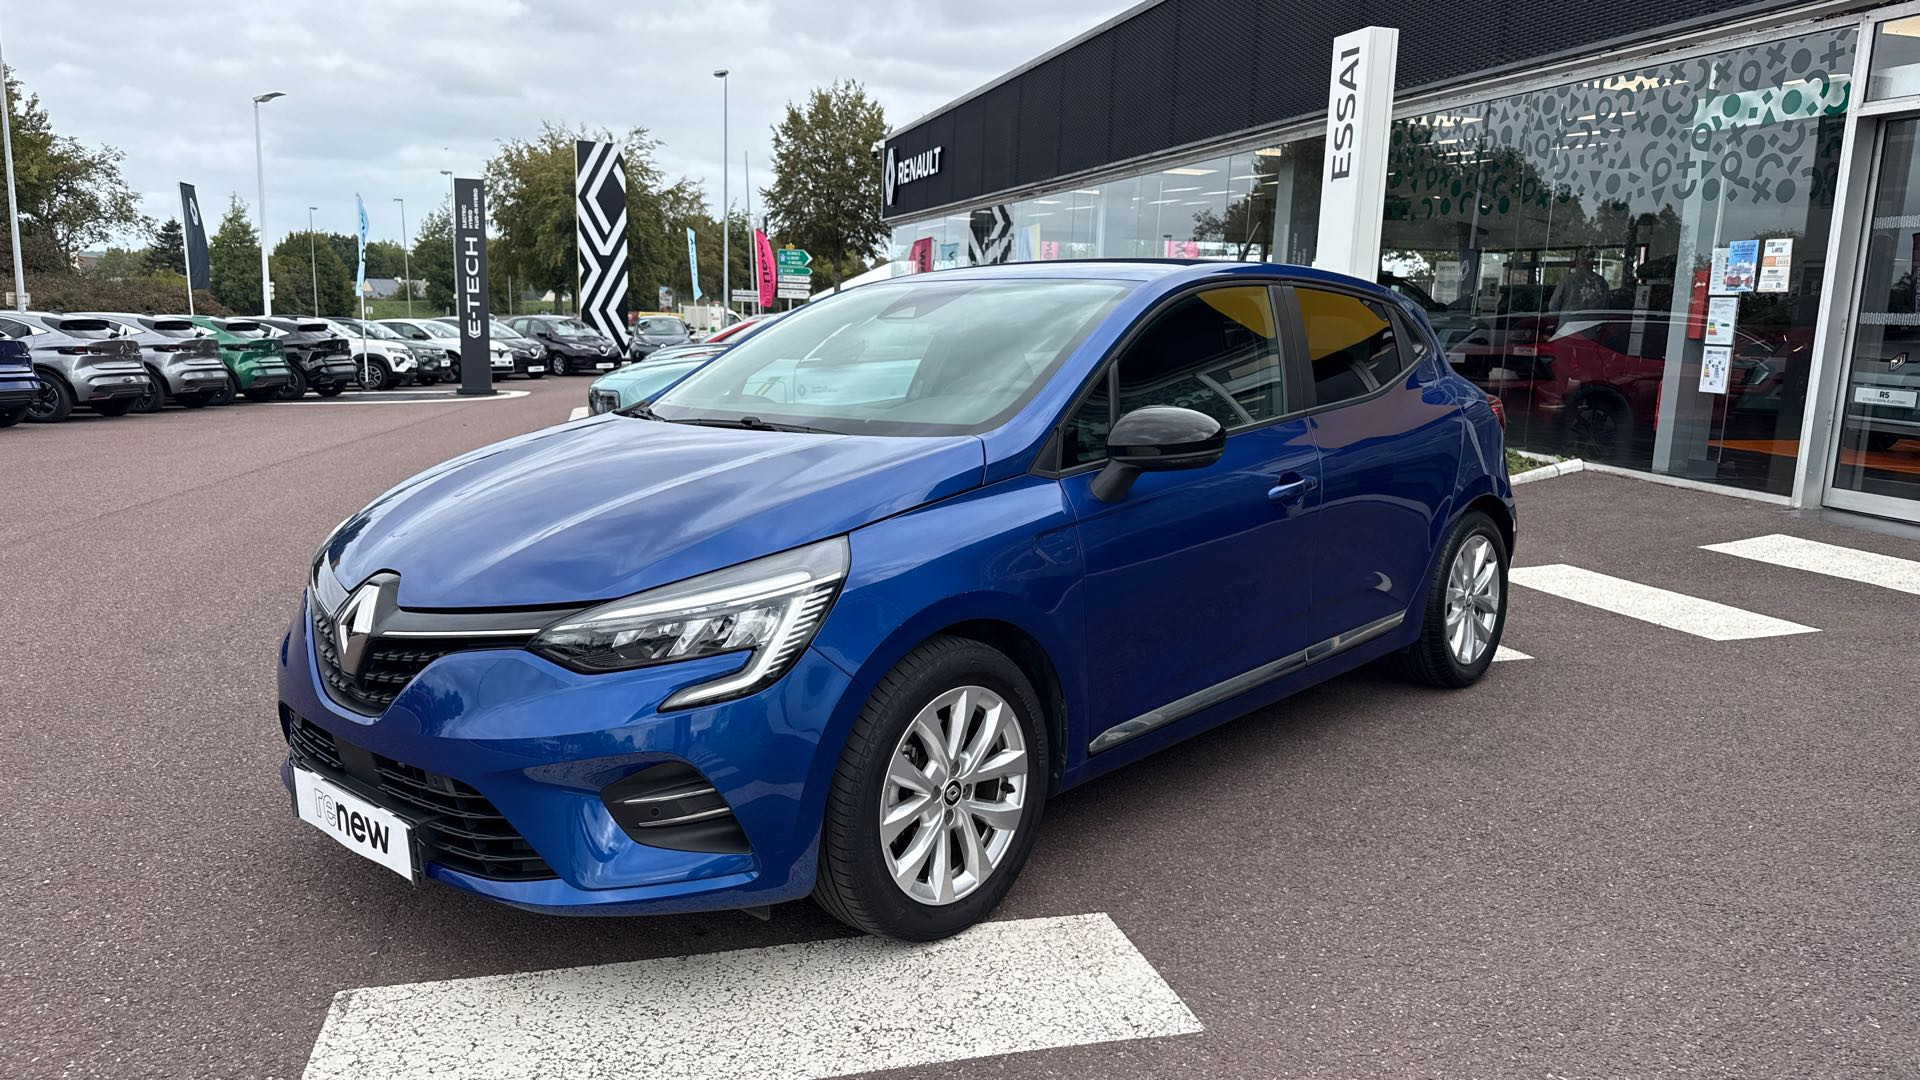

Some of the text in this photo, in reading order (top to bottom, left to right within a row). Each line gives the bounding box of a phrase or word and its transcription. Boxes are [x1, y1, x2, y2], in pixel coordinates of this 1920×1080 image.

[1331, 47, 1360, 182] ESSAI
[898, 146, 942, 185] RENAULT
[465, 237, 482, 338] E-TECH
[1879, 391, 1890, 399] R5
[314, 788, 389, 854] renew
